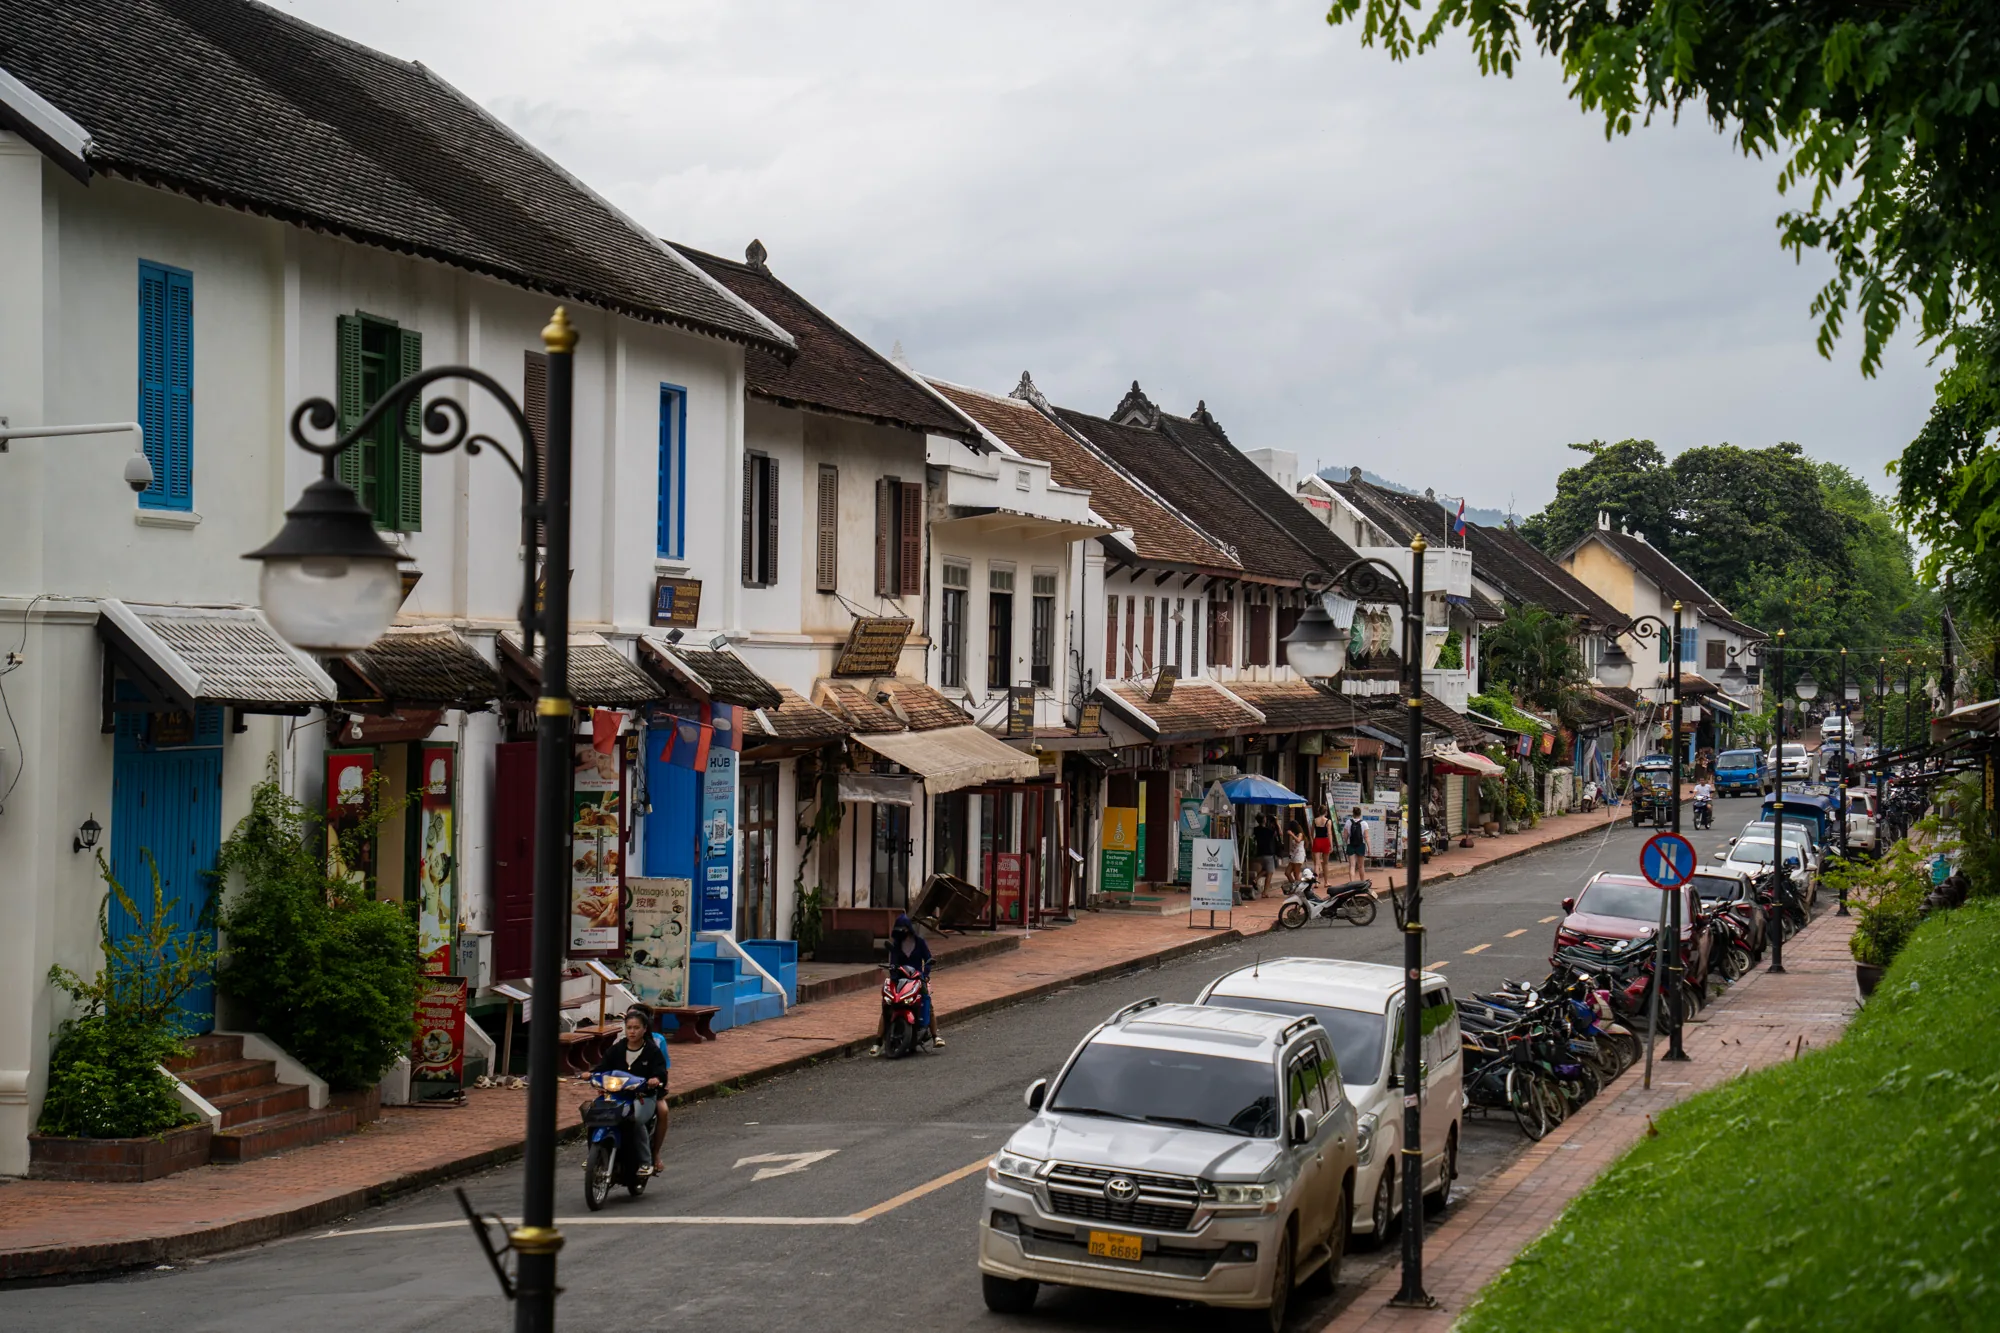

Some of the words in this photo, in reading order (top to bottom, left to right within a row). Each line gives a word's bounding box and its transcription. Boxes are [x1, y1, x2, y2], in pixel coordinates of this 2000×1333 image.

[633, 885, 664, 898] Massage
[671, 886, 685, 898] Spa
[1110, 1244, 1139, 1259] 8689
